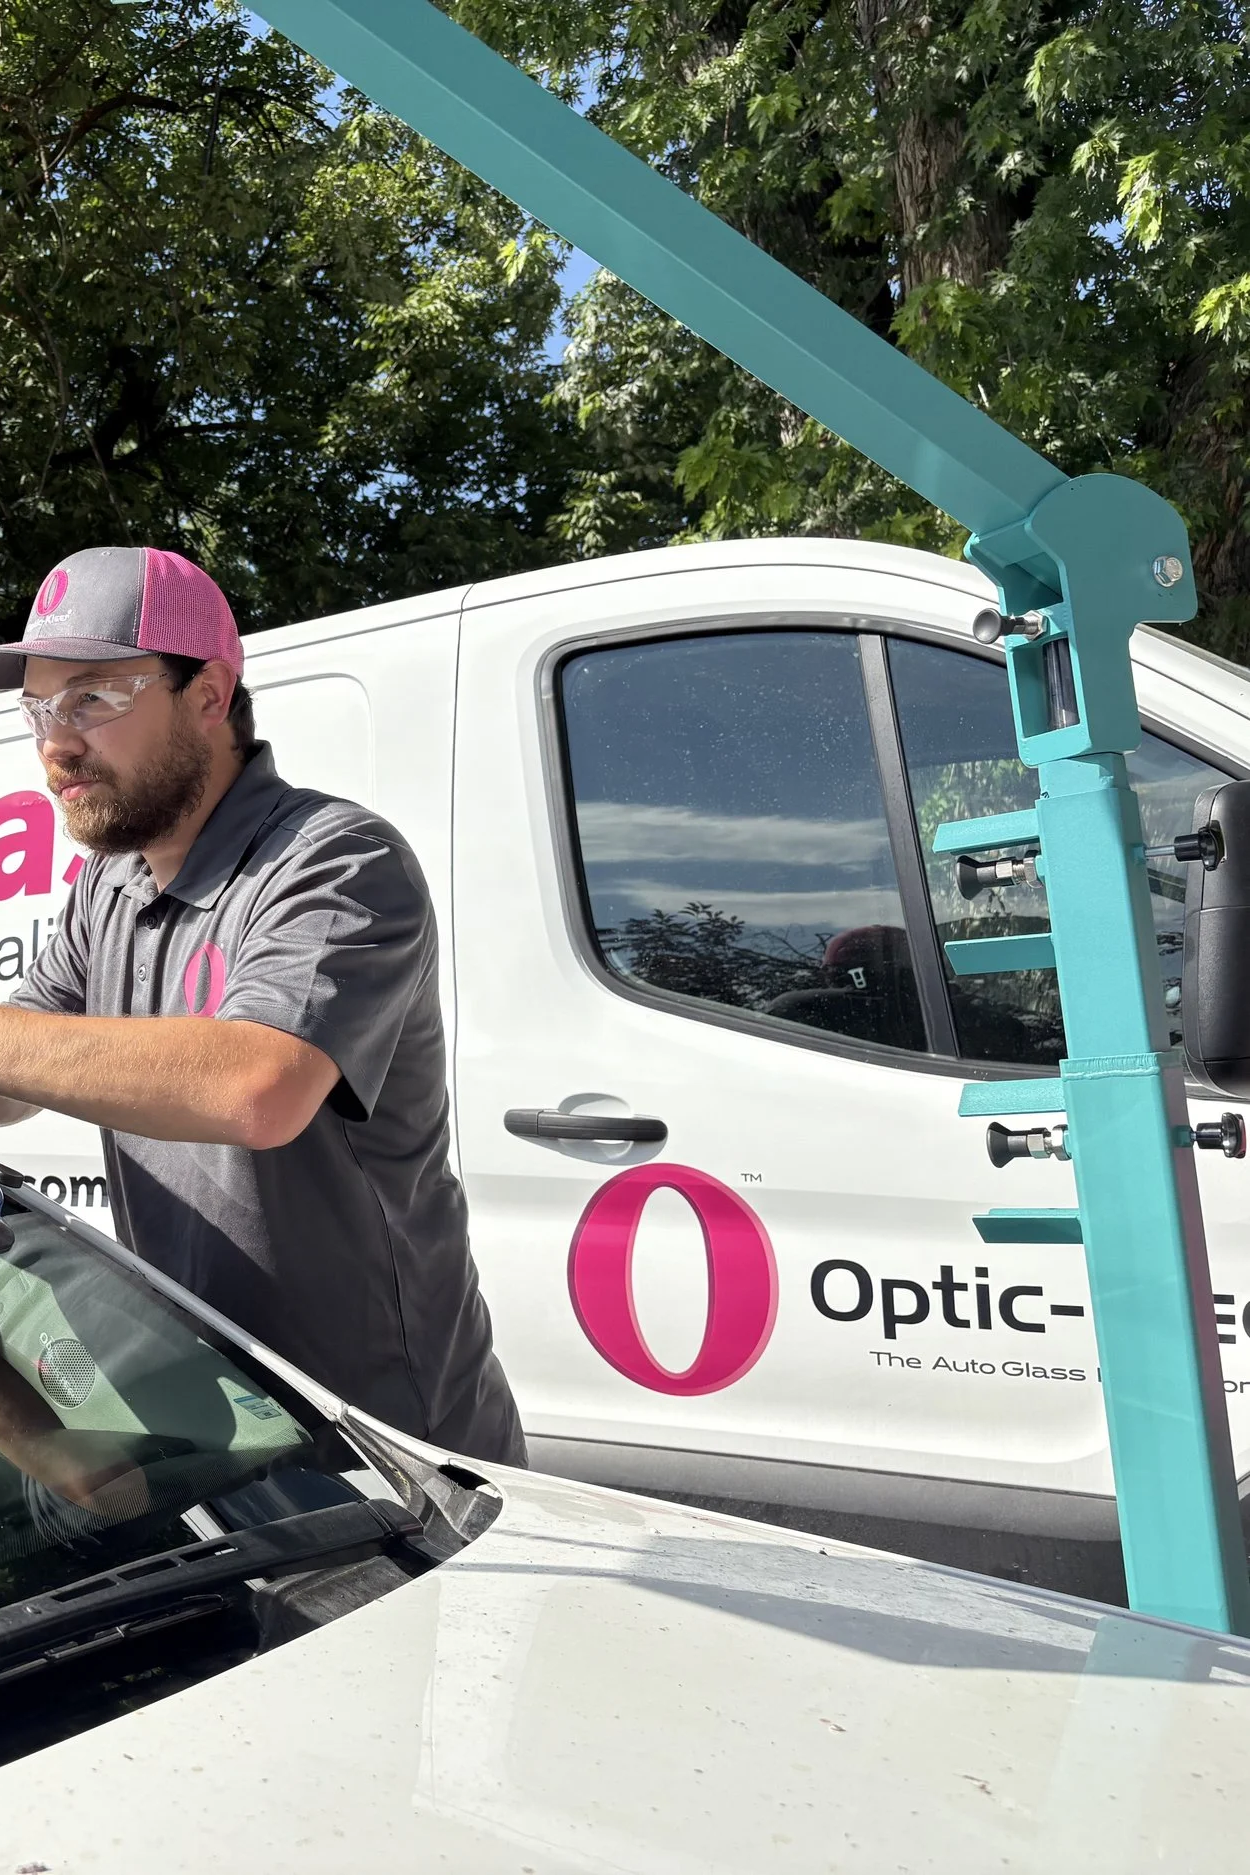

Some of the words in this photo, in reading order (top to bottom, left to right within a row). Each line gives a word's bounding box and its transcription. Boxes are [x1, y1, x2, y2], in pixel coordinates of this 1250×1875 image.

[869, 1351, 922, 1369] The
[932, 1356, 996, 1375] Auto
[1001, 1361, 1087, 1381] Glass
